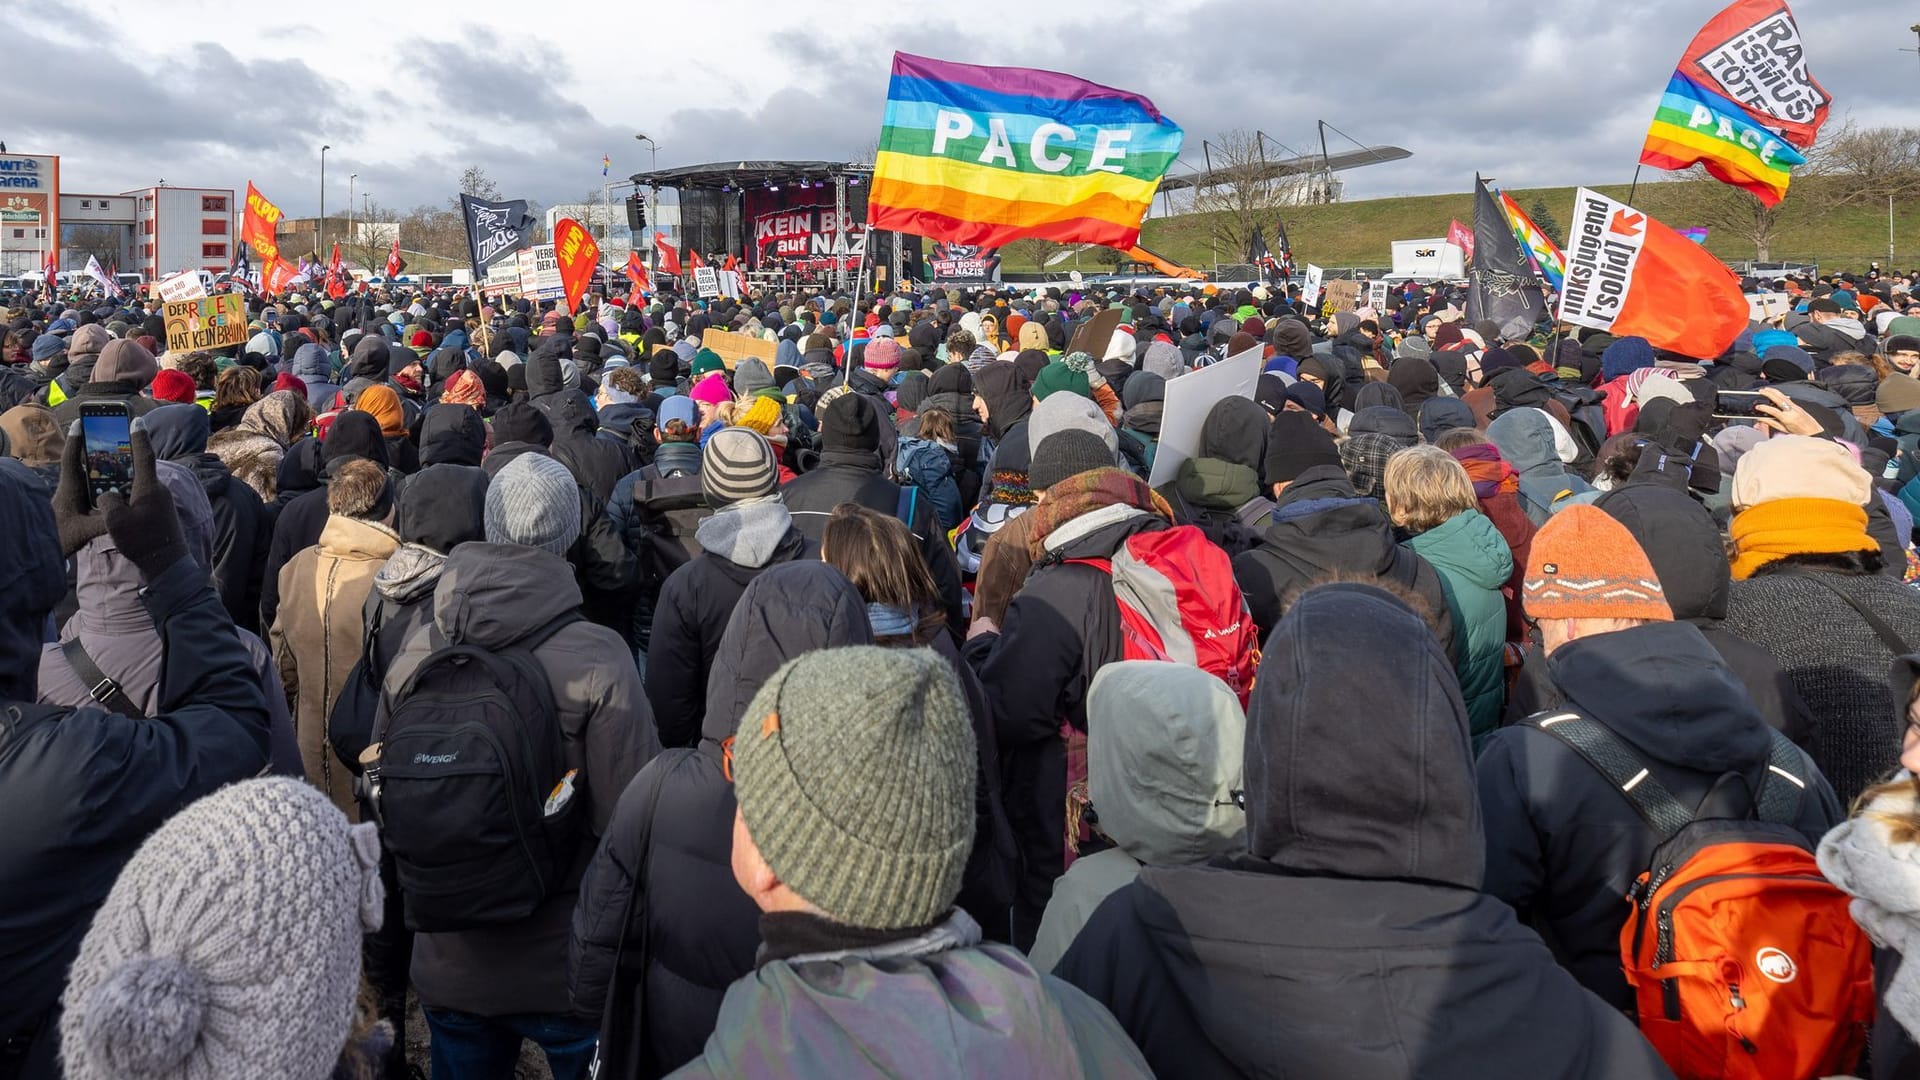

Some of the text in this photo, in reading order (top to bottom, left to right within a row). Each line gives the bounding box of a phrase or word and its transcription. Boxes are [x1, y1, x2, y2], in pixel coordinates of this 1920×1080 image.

[1712, 51, 1778, 118] TÖTE
[932, 109, 1132, 174] PACE
[1688, 104, 1784, 165] PACE
[0, 176, 38, 188] arena
[759, 213, 811, 239] KEIN
[777, 236, 807, 252] auf
[536, 259, 560, 271] DER A
[958, 260, 982, 268] BOCK
[1564, 198, 1609, 316] linksjugend
[699, 284, 717, 292] RECHTS
[168, 304, 189, 316] DER
[188, 295, 239, 318] REGEN
[170, 321, 247, 350] HAT KEIN BRAUN
